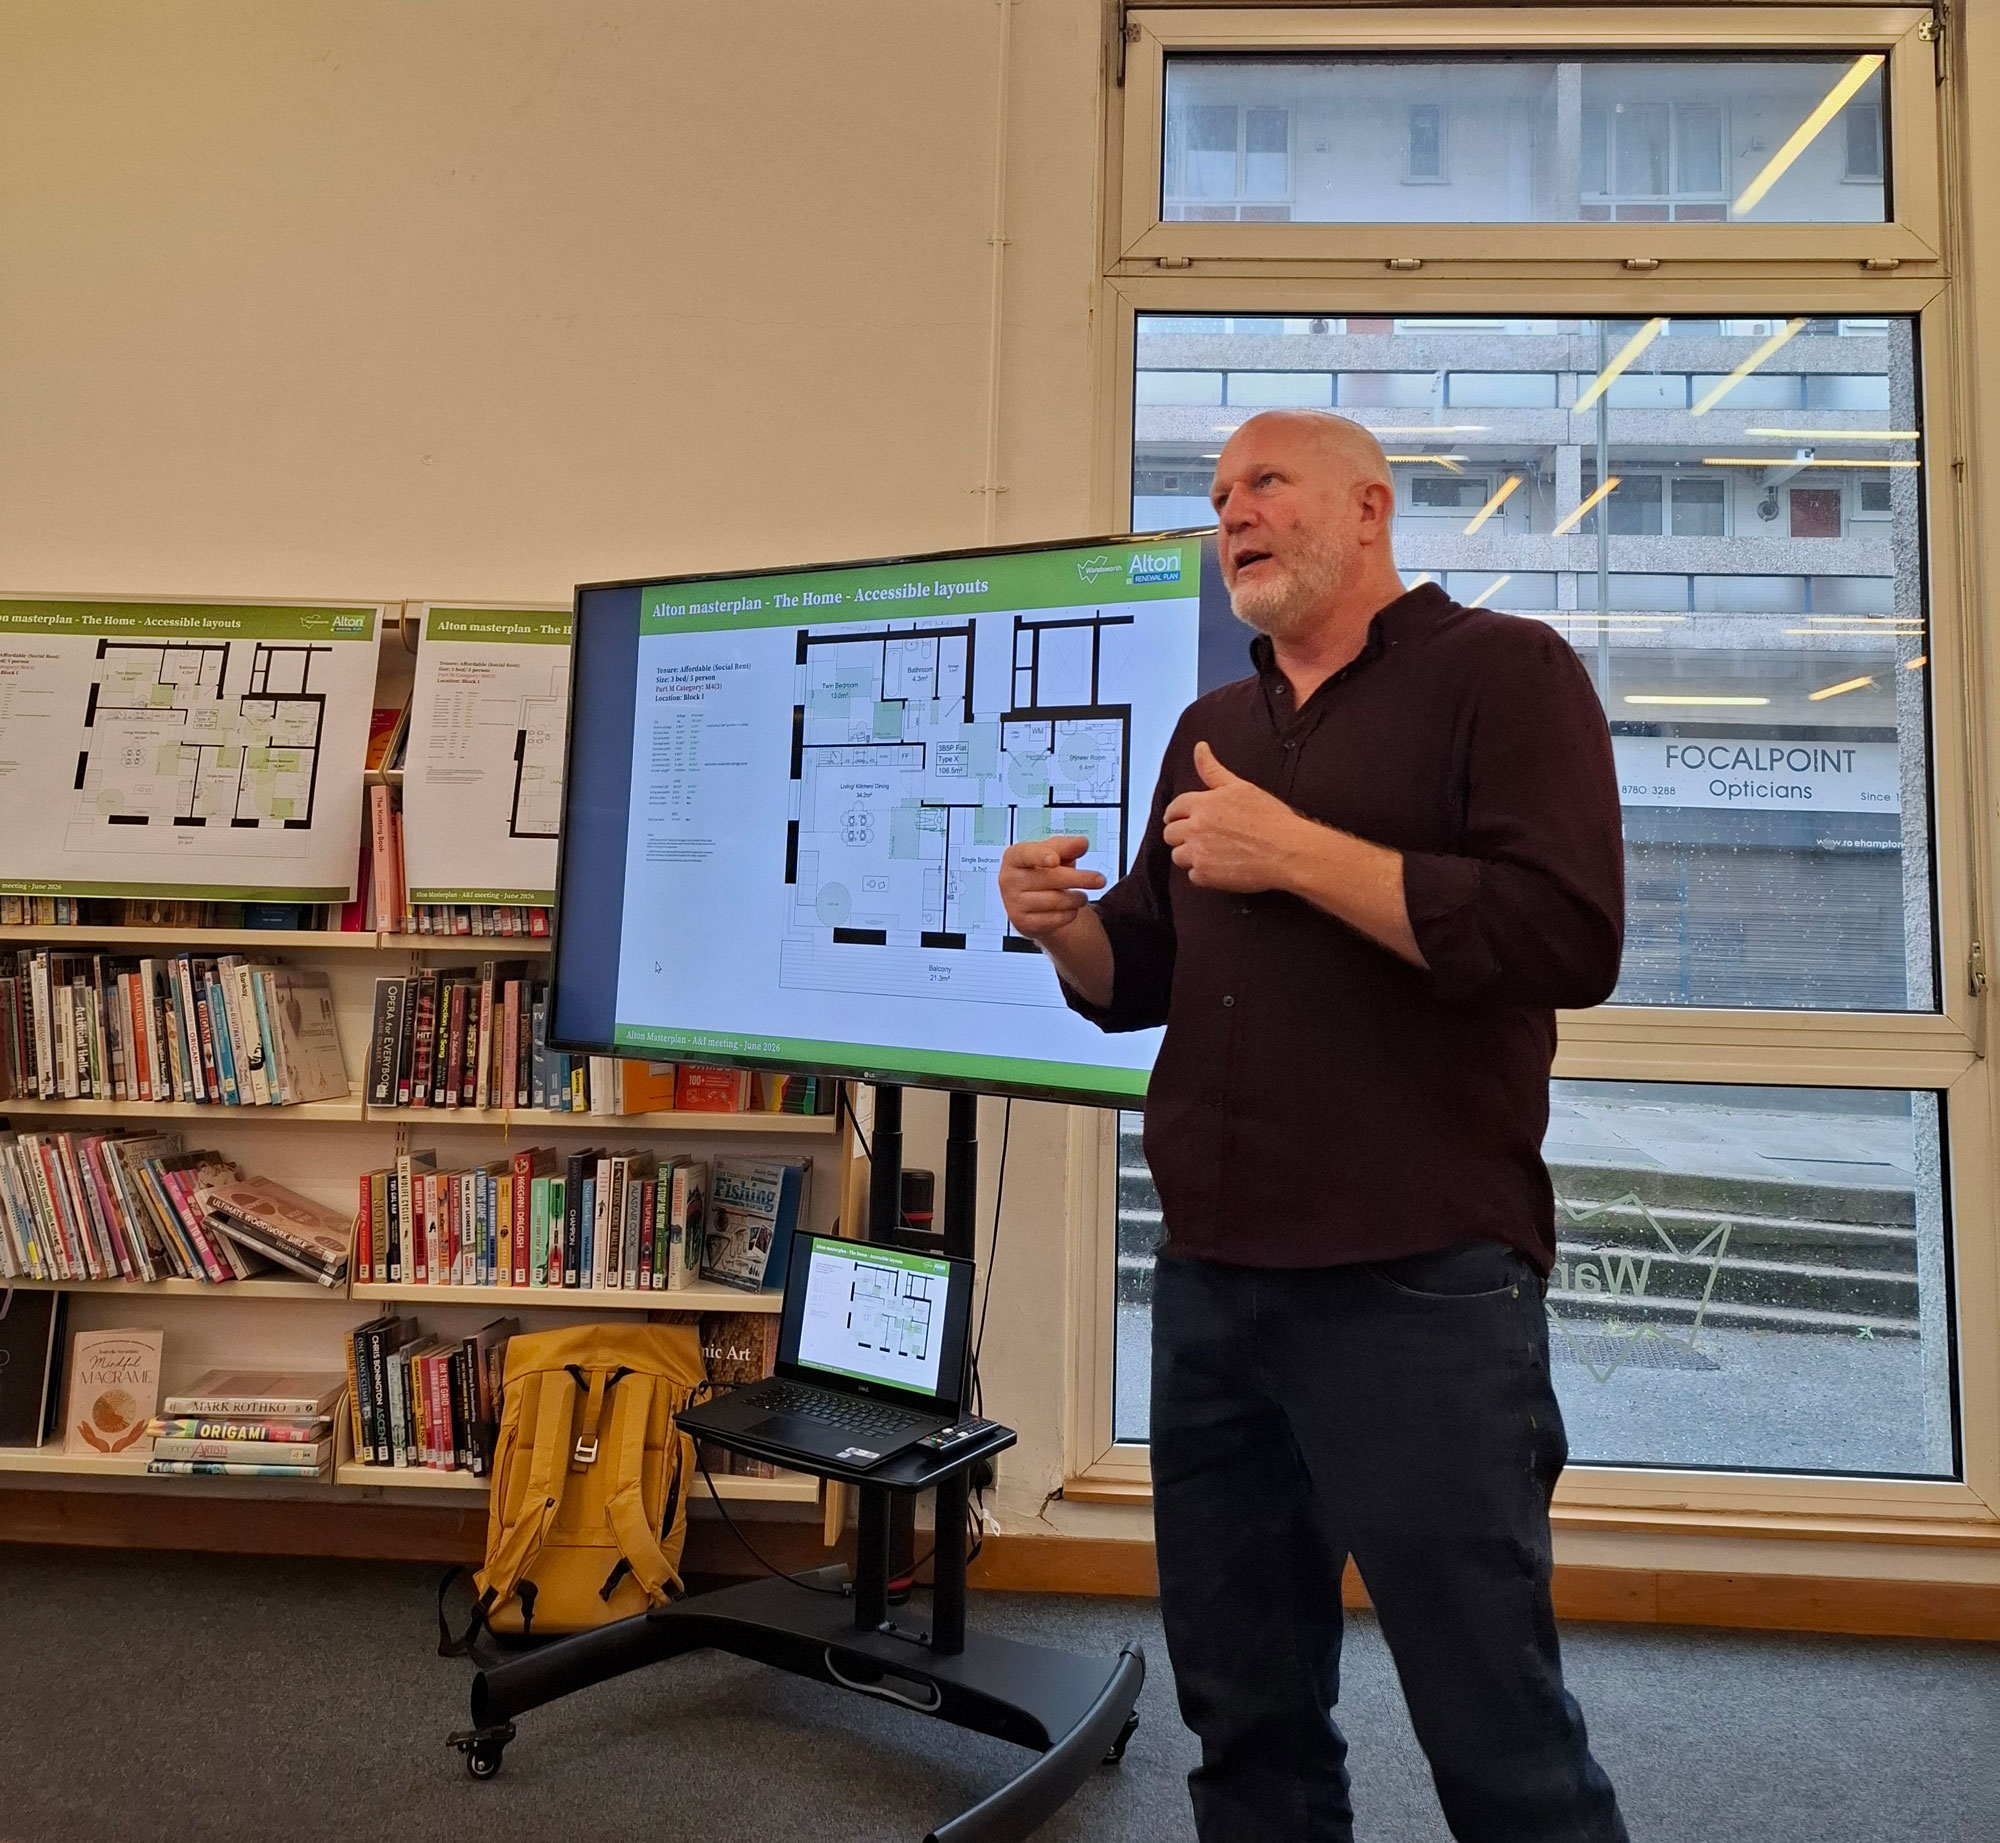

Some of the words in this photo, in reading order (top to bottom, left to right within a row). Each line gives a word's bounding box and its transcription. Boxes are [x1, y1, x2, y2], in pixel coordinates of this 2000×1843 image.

[1129, 554, 1179, 574] Alton
[1135, 574, 1161, 582] RENEWAL
[653, 603, 686, 617] Alton
[689, 599, 762, 615] masterplan
[774, 594, 798, 608] The
[802, 591, 842, 606] Home
[854, 583, 930, 601] Accessible
[934, 580, 989, 600] layouts
[12, 615, 72, 625] masterplan
[82, 616, 101, 625] The
[104, 616, 135, 626] Home
[144, 617, 200, 627] Accessible
[203, 618, 241, 629] layouts
[332, 616, 364, 627] Alton
[437, 622, 467, 631] Alton
[470, 623, 531, 634] masterplan
[540, 625, 561, 634] The
[713, 664, 733, 672] (Social
[676, 684, 704, 692] Category:
[695, 675, 715, 683] person
[1666, 744, 1856, 773] FOCALPOINT
[1652, 786, 1676, 795] 3288
[1709, 780, 1812, 800] Opticians
[1860, 792, 1890, 801] Since
[2, 882, 27, 891] meeting
[32, 883, 46, 891] June
[929, 965, 951, 973] Balcony
[386, 986, 397, 1019] OPERA
[441, 985, 451, 1026] Connection
[198, 1003, 210, 1045] ORIGAMI
[534, 1012, 544, 1020] TV
[75, 1007, 87, 1046] Artificial
[190, 1032, 198, 1065] ORIGAMI
[438, 1039, 447, 1058] Song
[627, 1030, 645, 1040] Alton
[647, 1033, 686, 1044] Masterplan
[708, 1039, 738, 1050] meeting
[744, 1040, 761, 1051] June
[763, 1043, 780, 1052] 2026
[78, 1050, 88, 1073] Hells
[659, 1168, 667, 1186] DON'T
[41, 1187, 49, 1208] Knitted
[517, 1176, 525, 1207] KEEGAN
[658, 1187, 666, 1203] STOP
[714, 1176, 776, 1212] Fishing
[373, 1198, 384, 1217] MO
[415, 1201, 423, 1214] PLAY
[477, 1203, 486, 1219] GAME
[630, 1186, 638, 1220] ALASTAIR
[657, 1204, 665, 1213] ME
[181, 1208, 193, 1226] HOW
[190, 1227, 199, 1237] TO
[212, 1198, 245, 1219] ULTIMATE
[245, 1214, 289, 1240] WOODWORK
[288, 1234, 307, 1249] BIBLE
[612, 1207, 620, 1230] CRICKET
[656, 1214, 665, 1229] NOW
[374, 1220, 385, 1261] FARAH
[629, 1222, 637, 1248] COOK
[347, 1340, 356, 1369] FINDING
[372, 1335, 380, 1358] CHRIS
[727, 1347, 750, 1361] Art
[90, 1355, 142, 1370] Mindful
[439, 1363, 447, 1373] ON
[374, 1359, 382, 1405] BONINGTON
[440, 1374, 448, 1387] THE
[441, 1388, 449, 1406] GRID
[192, 1402, 230, 1412] MARK
[233, 1402, 287, 1413] ROTHKO
[200, 1424, 265, 1439] ORIGAMI
[376, 1407, 385, 1446] ASCENT
[191, 1442, 228, 1458] ARTISTS
